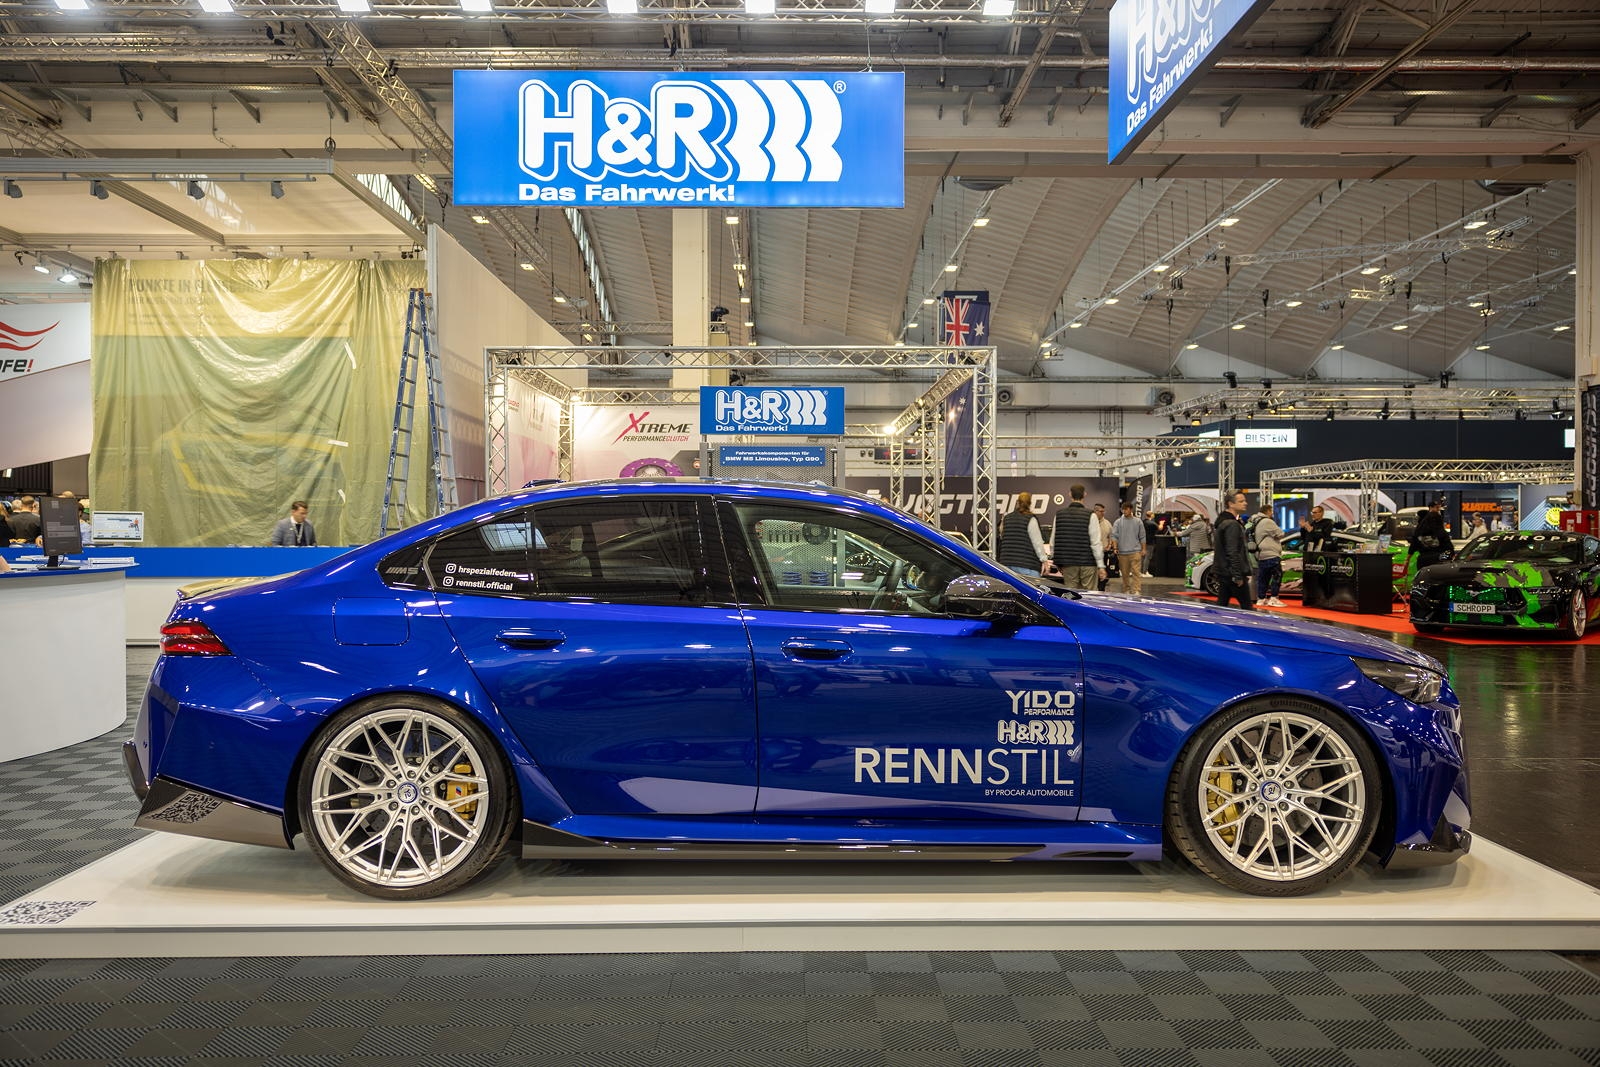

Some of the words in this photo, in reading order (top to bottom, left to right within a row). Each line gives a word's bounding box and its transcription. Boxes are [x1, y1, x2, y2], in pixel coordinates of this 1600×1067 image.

[1126, 100, 1147, 137] Das
[1149, 18, 1213, 110] Fahrwerk!
[518, 79, 735, 182] H&R
[518, 184, 577, 201] Das
[585, 183, 735, 201] Fahrwerk!
[715, 389, 791, 425] H&R
[611, 411, 693, 446] XTREME
[715, 424, 735, 432] Das
[737, 424, 788, 432] Fahrwerk!
[1477, 534, 1577, 543] SCHROPP
[456, 578, 513, 591] rennstil.official
[1456, 603, 1492, 613] SCHROPP
[1004, 690, 1075, 715] YIDO
[1023, 708, 1075, 716] PERFORMANCE
[997, 719, 1050, 745] H&R
[854, 747, 1074, 785] RENNSTIL
[984, 789, 994, 797] BY
[995, 789, 1026, 797] PROCAR
[1026, 789, 1074, 797] AUTOMOBILE
